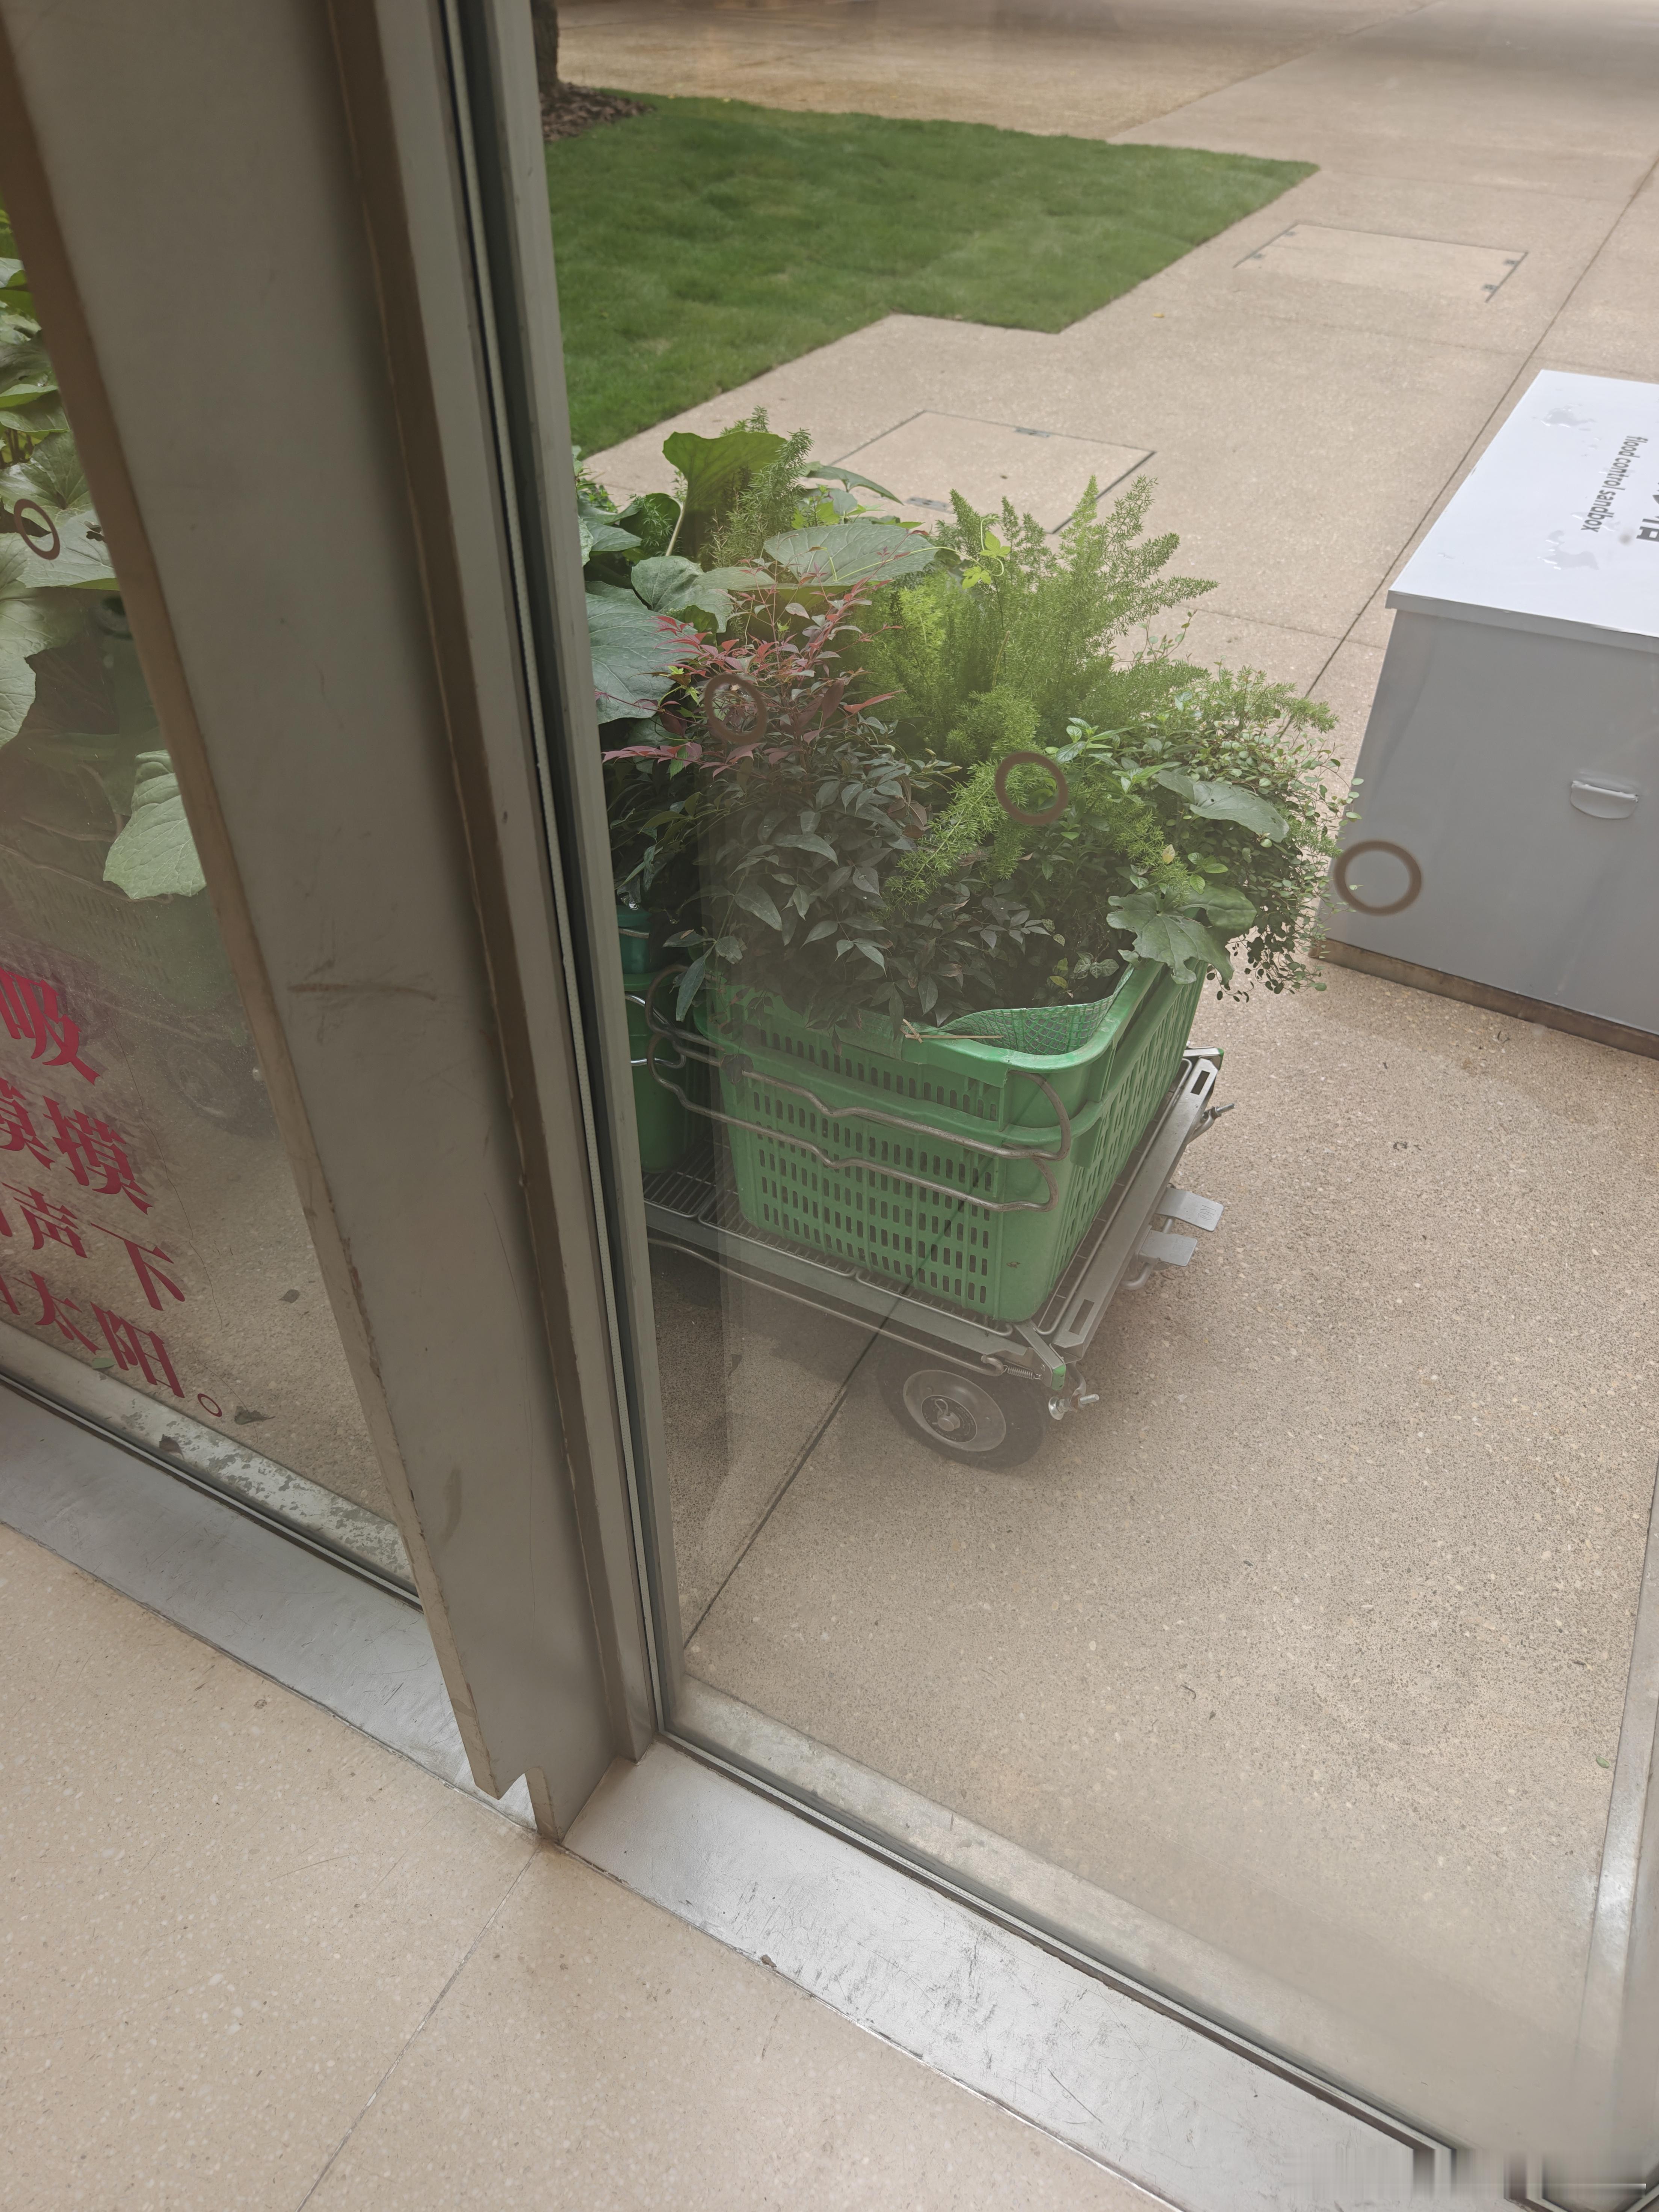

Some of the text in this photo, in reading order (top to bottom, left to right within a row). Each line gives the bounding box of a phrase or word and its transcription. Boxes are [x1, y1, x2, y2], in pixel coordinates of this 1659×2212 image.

[1618, 436, 1648, 458] flood
[1602, 458, 1631, 490] control
[1580, 490, 1616, 532] sandbox
[0, 1182, 185, 1311] 声下
[0, 1270, 222, 1417] 太阳。
